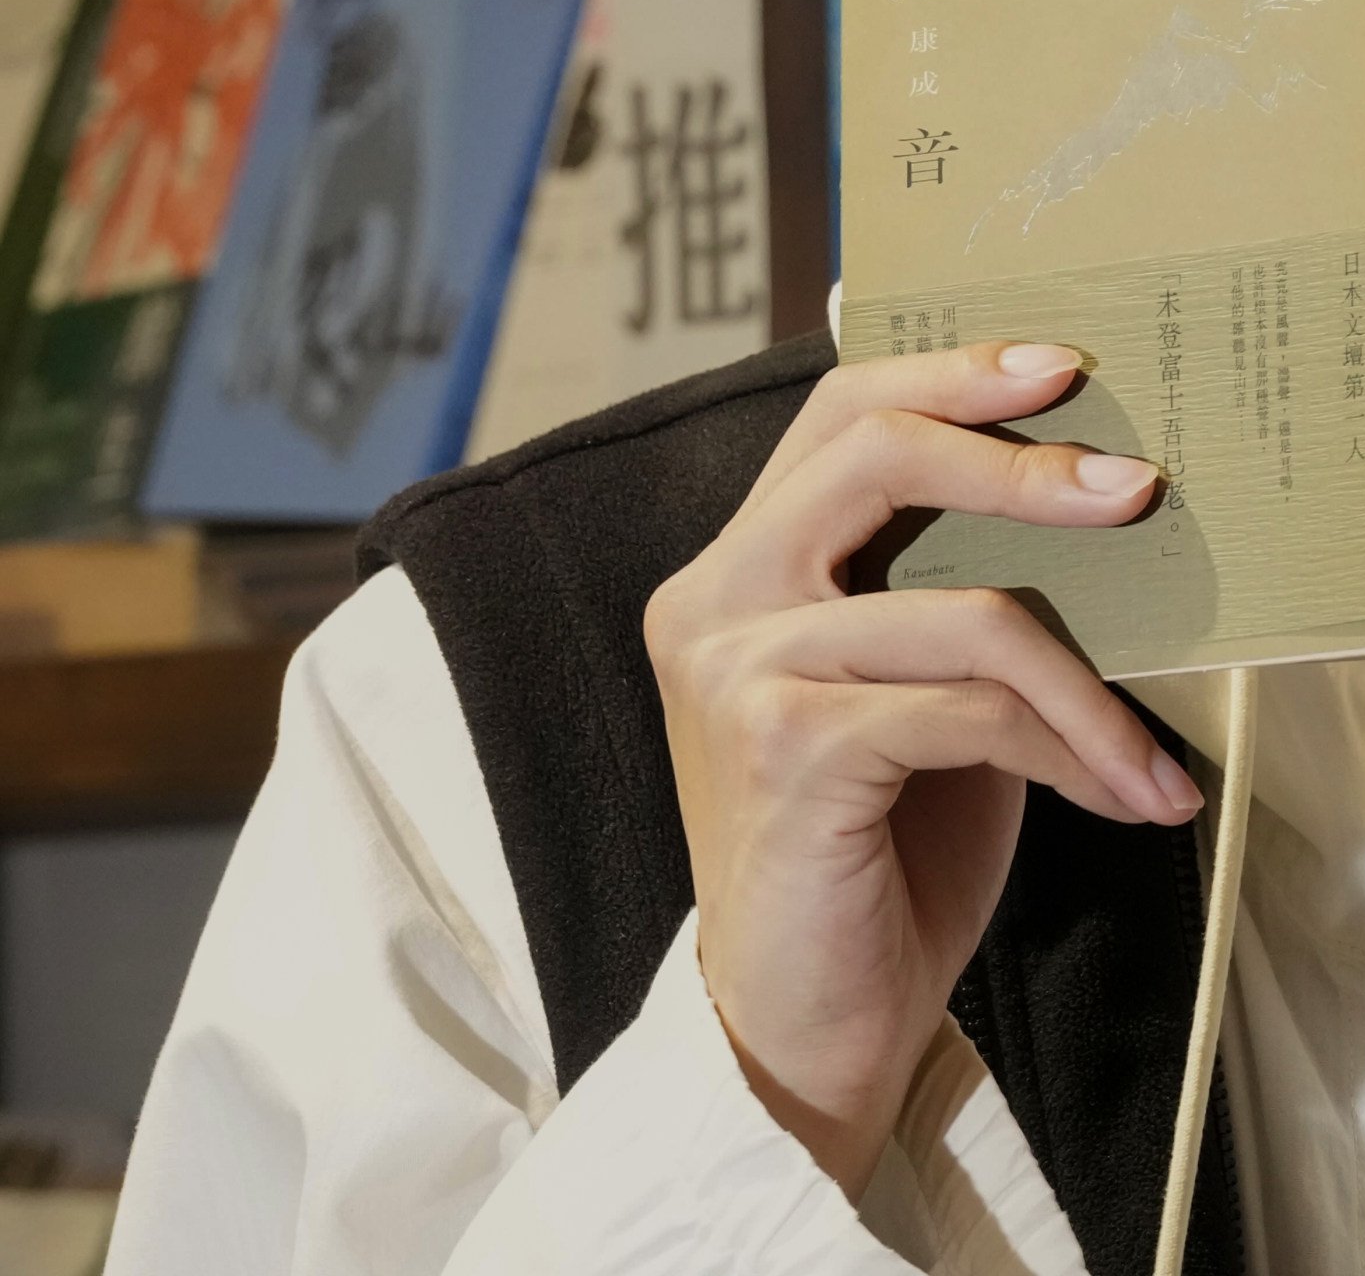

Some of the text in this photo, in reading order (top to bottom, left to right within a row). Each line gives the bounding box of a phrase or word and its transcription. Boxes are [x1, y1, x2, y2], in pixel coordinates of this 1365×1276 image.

[909, 26, 940, 96] 康成
[892, 127, 960, 189] 音
[903, 562, 956, 581] Kawabata
